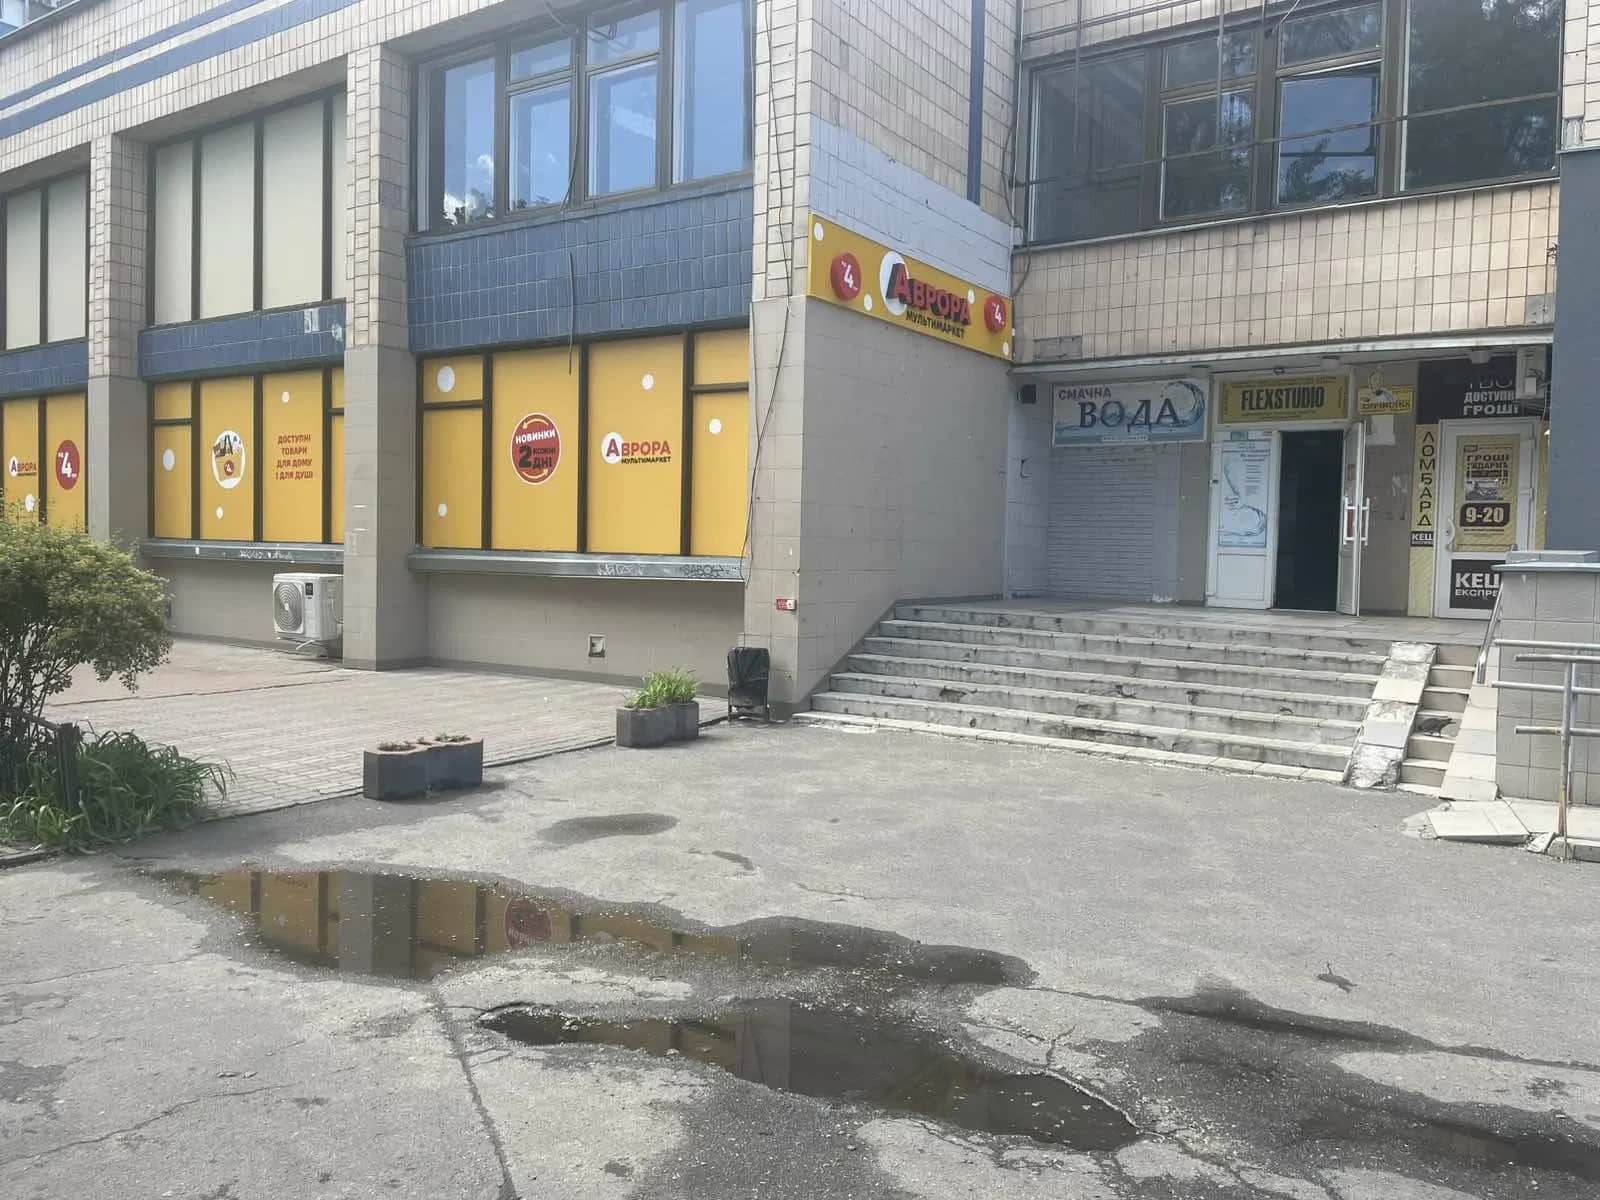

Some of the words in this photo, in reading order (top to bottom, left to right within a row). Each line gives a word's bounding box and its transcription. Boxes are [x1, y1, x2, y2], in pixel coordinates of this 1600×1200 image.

[843, 264, 854, 289] 4
[887, 263, 971, 325] АВРОРА
[994, 304, 1002, 324] 4
[906, 310, 965, 338] МУЛЬТИМАРКЕТ
[1058, 386, 1112, 400] СМАЧНА
[1241, 386, 1325, 411] FLEXSTUDIO
[1078, 397, 1181, 433] ВОДА
[1464, 404, 1518, 416] ГРОШІ
[277, 434, 311, 445] ДОСТУПНІ
[515, 428, 556, 444] НОВИНКИ
[281, 447, 307, 455] ТОВАРИ
[606, 438, 672, 457] АВРОРА
[277, 459, 291, 469] ДЛЯ
[292, 458, 312, 468] ДОМУ
[518, 444, 532, 469] 2
[532, 456, 552, 470] ДНІ
[621, 456, 672, 465] МУЛЬТИМАРКЕТ
[1466, 454, 1509, 462] ГРОШІ
[61, 452, 72, 478] 4
[279, 471, 293, 480] ДЛЯ
[295, 471, 313, 480] ДУШІ
[1417, 431, 1436, 526] ЛОМБАРД
[1465, 506, 1505, 523] 9-20
[1455, 588, 1498, 598] ЕКСПРЕ
